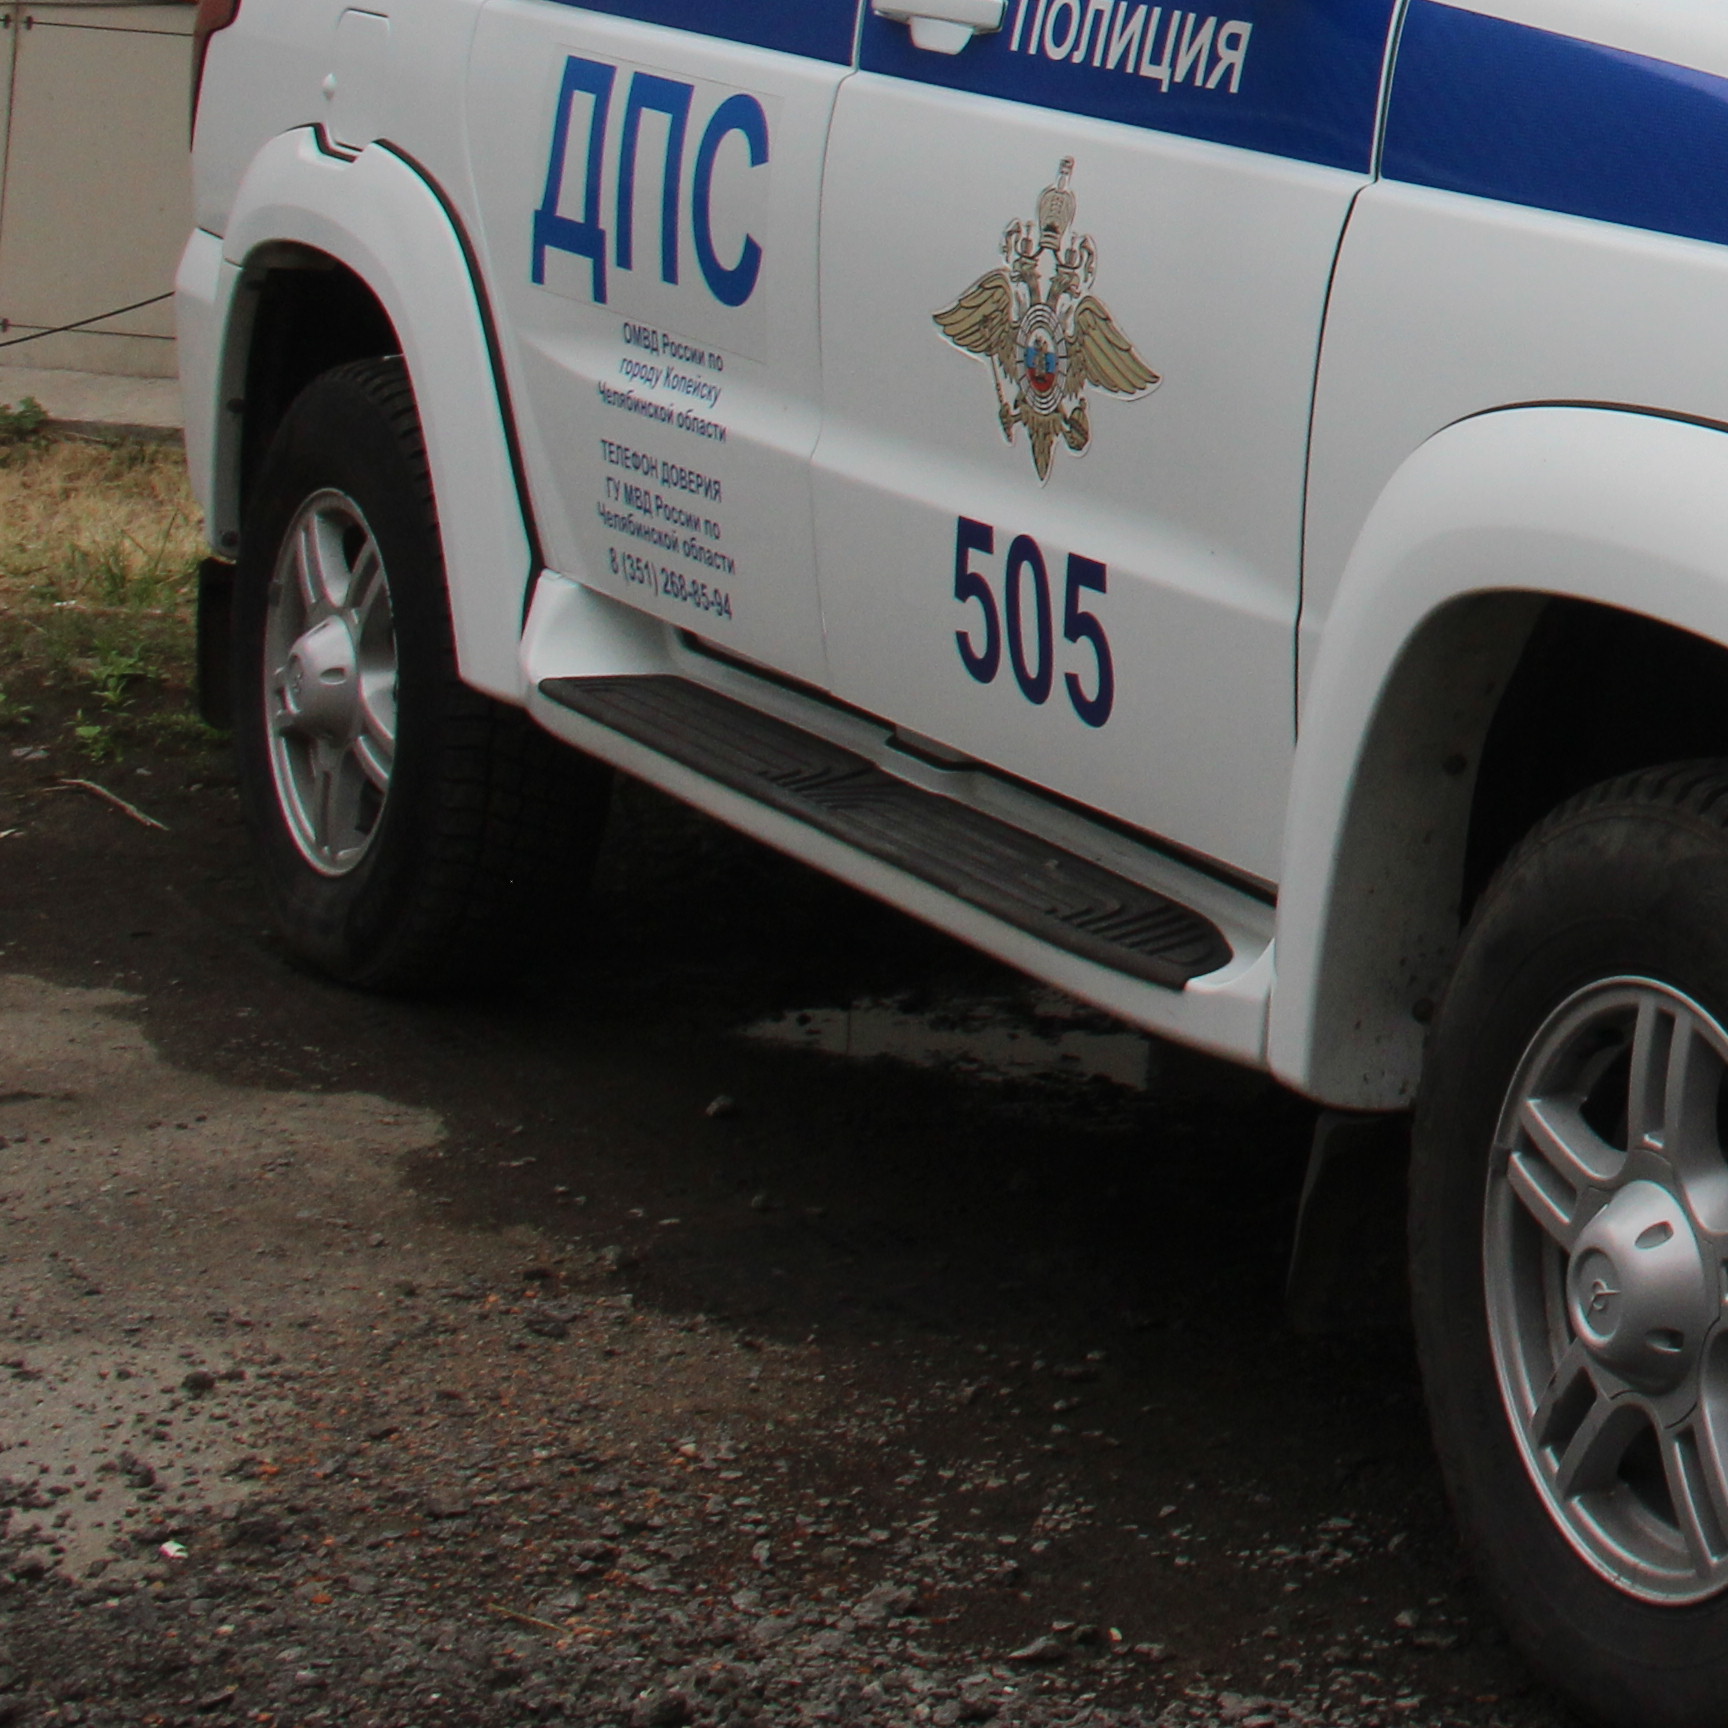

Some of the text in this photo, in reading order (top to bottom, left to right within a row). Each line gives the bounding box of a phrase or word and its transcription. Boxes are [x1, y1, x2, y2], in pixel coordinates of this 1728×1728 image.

[531, 55, 769, 307] ДПС
[623, 322, 724, 372] ОМВД России по
[598, 380, 727, 442] Челябинской области
[619, 358, 722, 408] городу Копейску
[600, 439, 722, 503] ТЕЛЕФОН ДОВЕРИЯ
[597, 501, 735, 575] Челябинской области
[605, 476, 721, 540] ГУ МВД России по
[609, 547, 733, 620] 8 (351) 268-85-94
[954, 515, 1114, 728] 505
